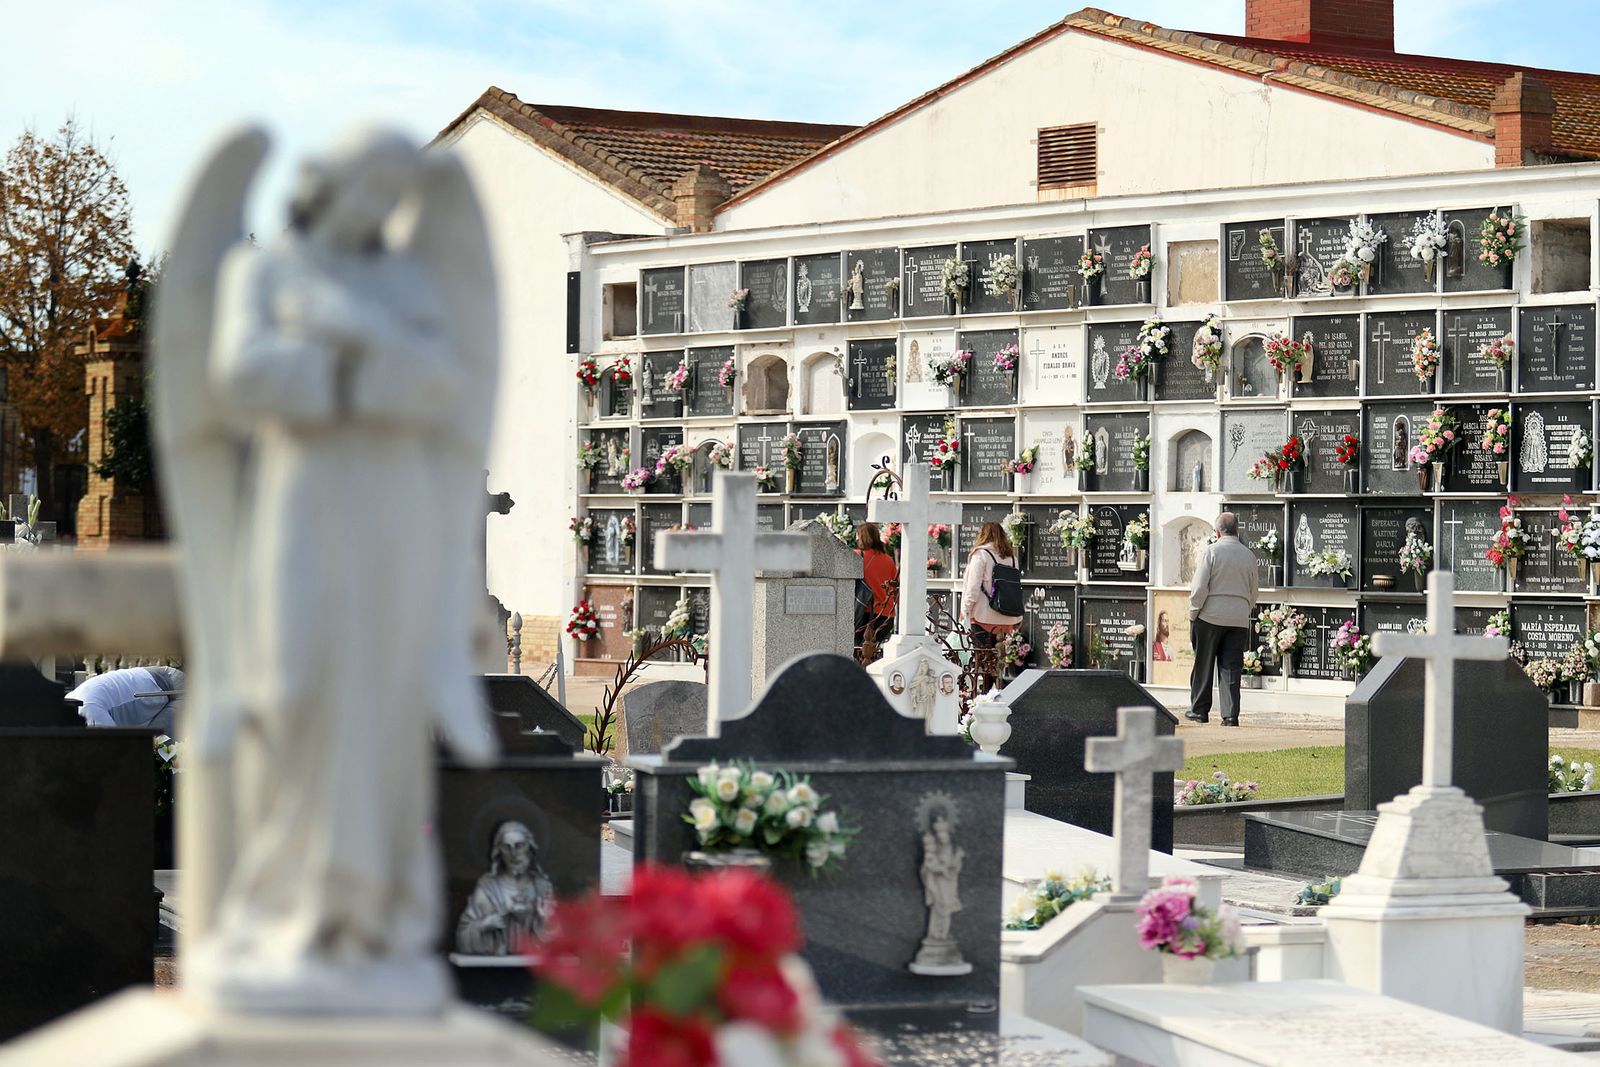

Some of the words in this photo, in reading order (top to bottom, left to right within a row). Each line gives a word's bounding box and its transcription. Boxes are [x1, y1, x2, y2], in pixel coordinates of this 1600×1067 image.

[1248, 522, 1277, 531] FAMILIA
[1371, 519, 1400, 527] ESPERANZA
[1521, 621, 1542, 631] MARÍA
[1544, 623, 1580, 632] ESPERANZA
[1548, 633, 1574, 642] MORENO
